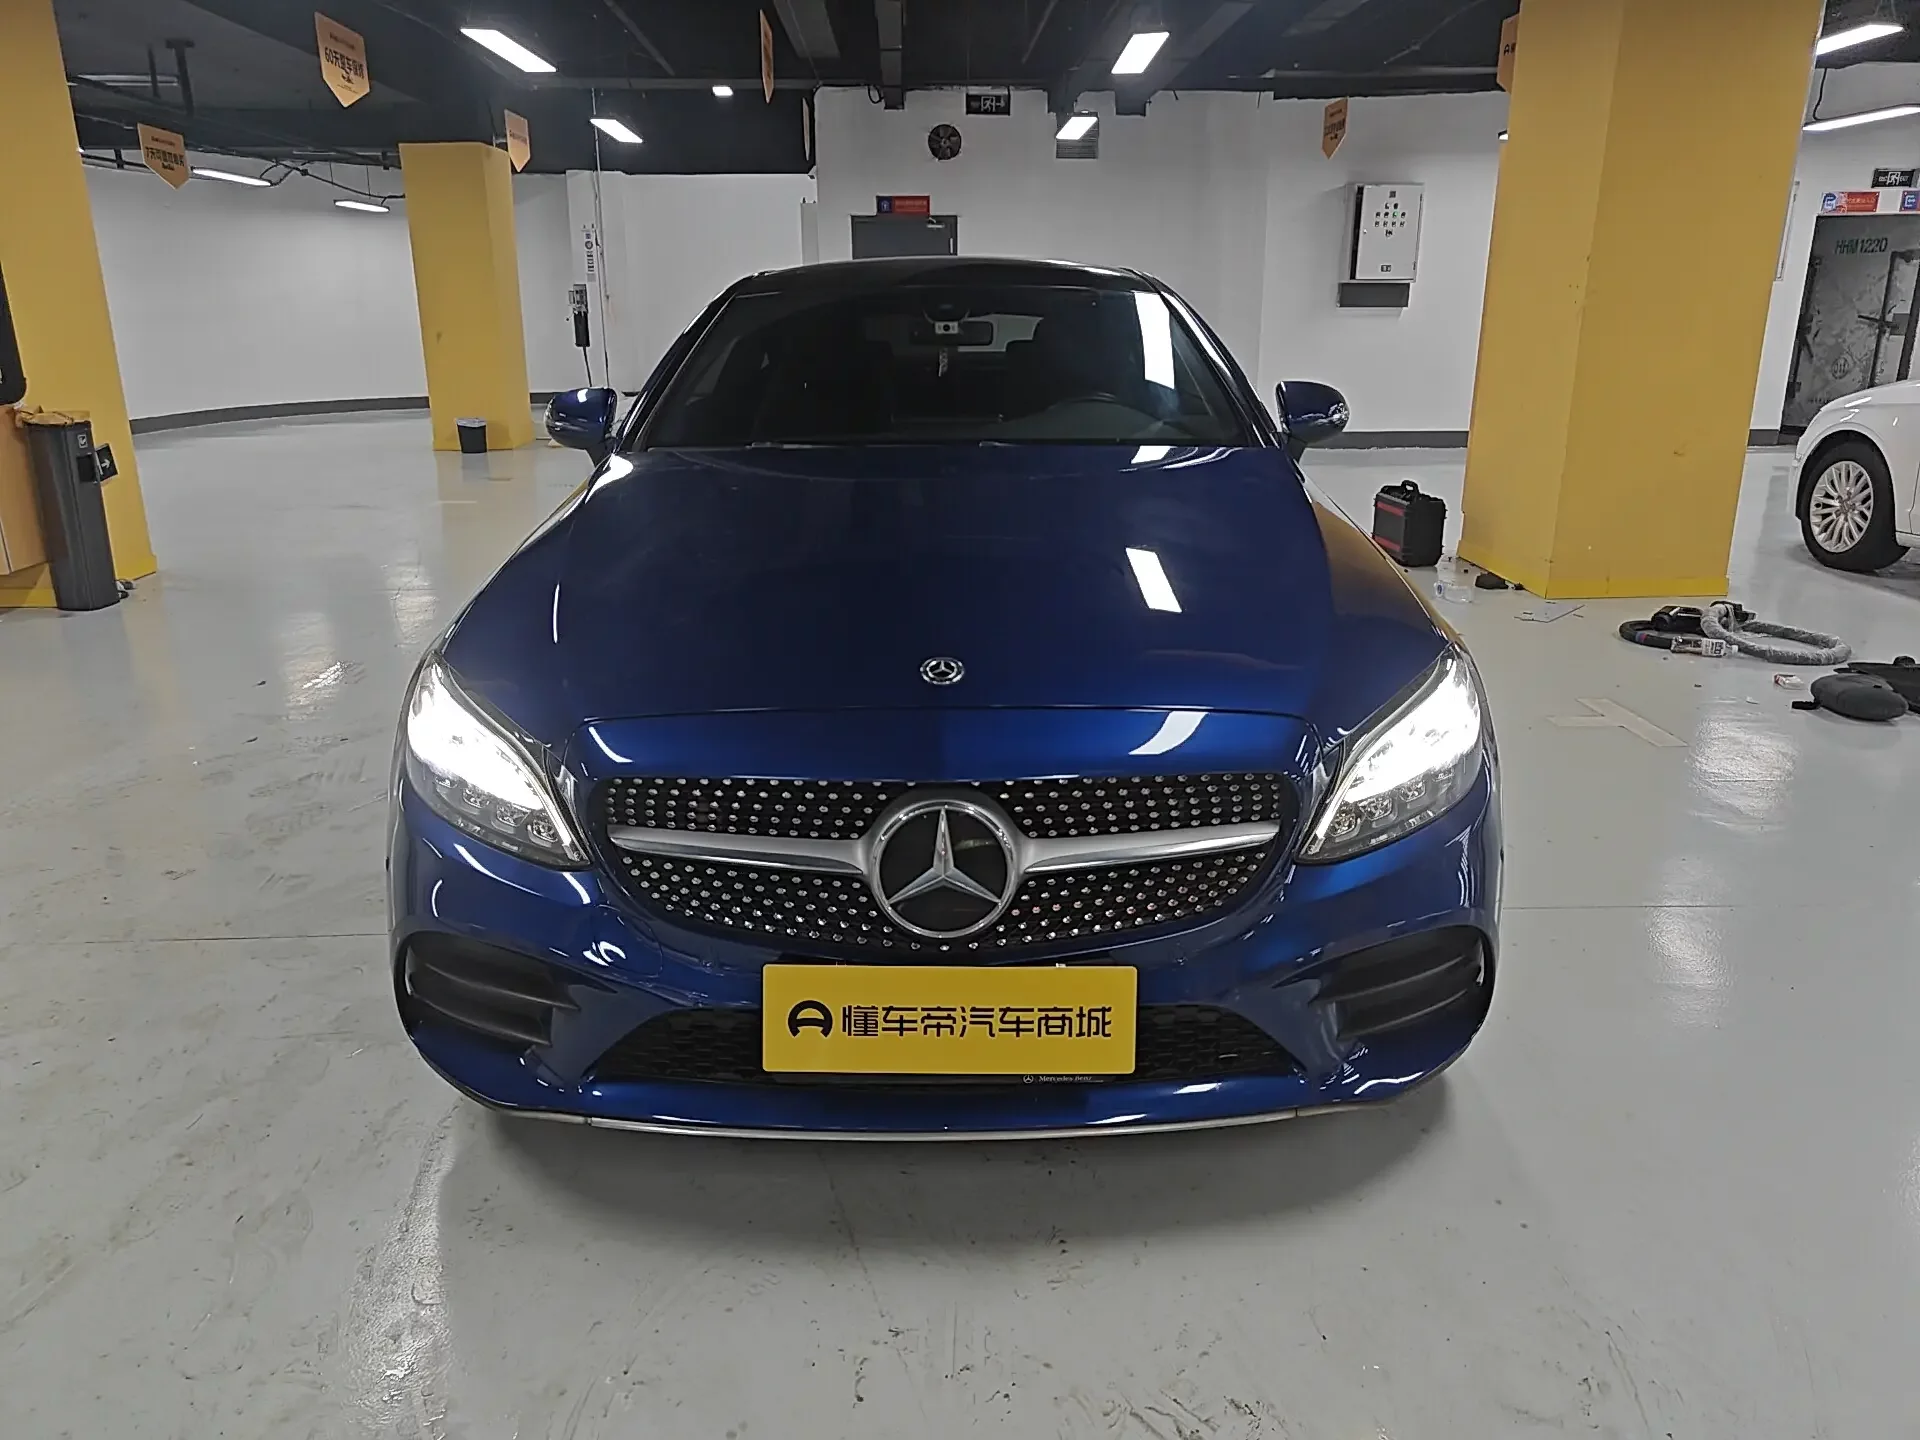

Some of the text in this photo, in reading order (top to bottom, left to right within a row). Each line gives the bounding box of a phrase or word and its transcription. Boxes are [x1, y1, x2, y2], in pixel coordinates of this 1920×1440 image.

[841, 1004, 1113, 1038] 懂车帝汽车商城
